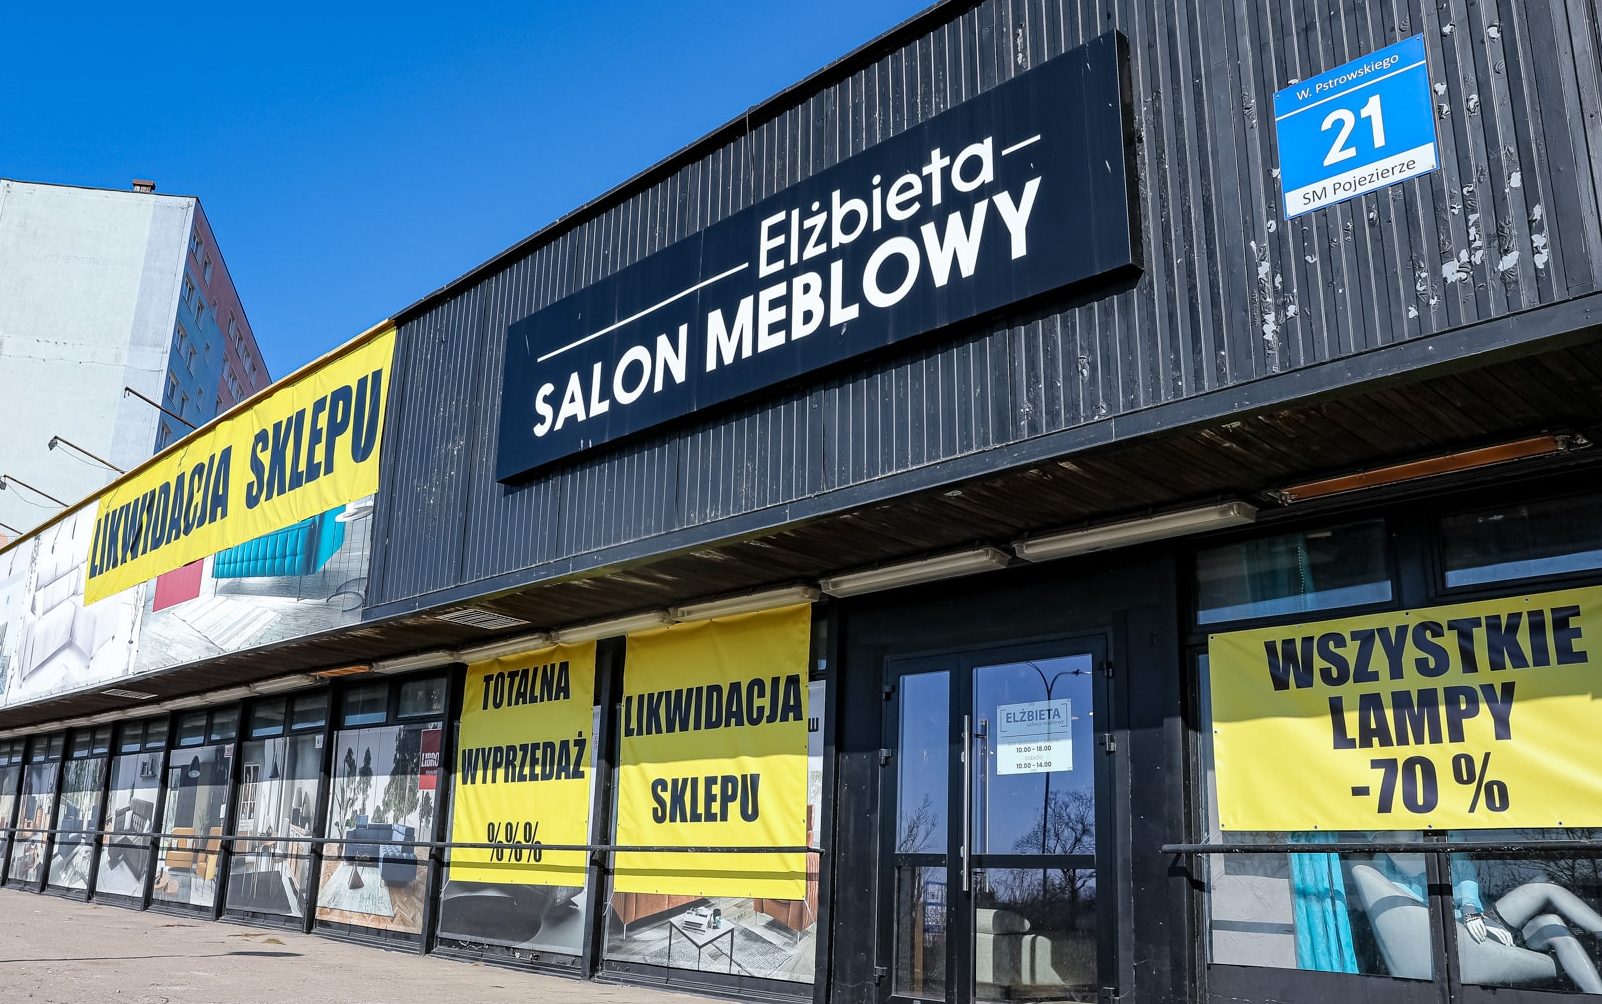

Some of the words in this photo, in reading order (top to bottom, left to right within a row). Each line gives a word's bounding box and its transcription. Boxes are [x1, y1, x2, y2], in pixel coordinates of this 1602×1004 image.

[1296, 88, 1312, 101] W.
[1315, 54, 1399, 94] Pstrowskiego
[1320, 93, 1386, 167] 21
[758, 136, 995, 279] Elżbieta
[1302, 187, 1327, 206] SM
[1333, 158, 1416, 195] Pojezierze
[533, 324, 688, 438] SALON
[706, 175, 1042, 373] MEBLOWY
[88, 444, 232, 580] LIKWIDACJA
[245, 368, 383, 510] SKLEPU
[1264, 604, 1589, 692] WSZYSTKIE
[482, 661, 571, 711] TOTALNA
[623, 673, 804, 738] LIKWIDACJA
[1006, 708, 1061, 724] ELŻBIETA
[1328, 681, 1517, 750] LAMPY
[461, 730, 587, 786] WYPRZEDAŻ
[1351, 755, 1439, 815] -70
[1452, 752, 1511, 814] %
[651, 773, 761, 825] SKLEPU
